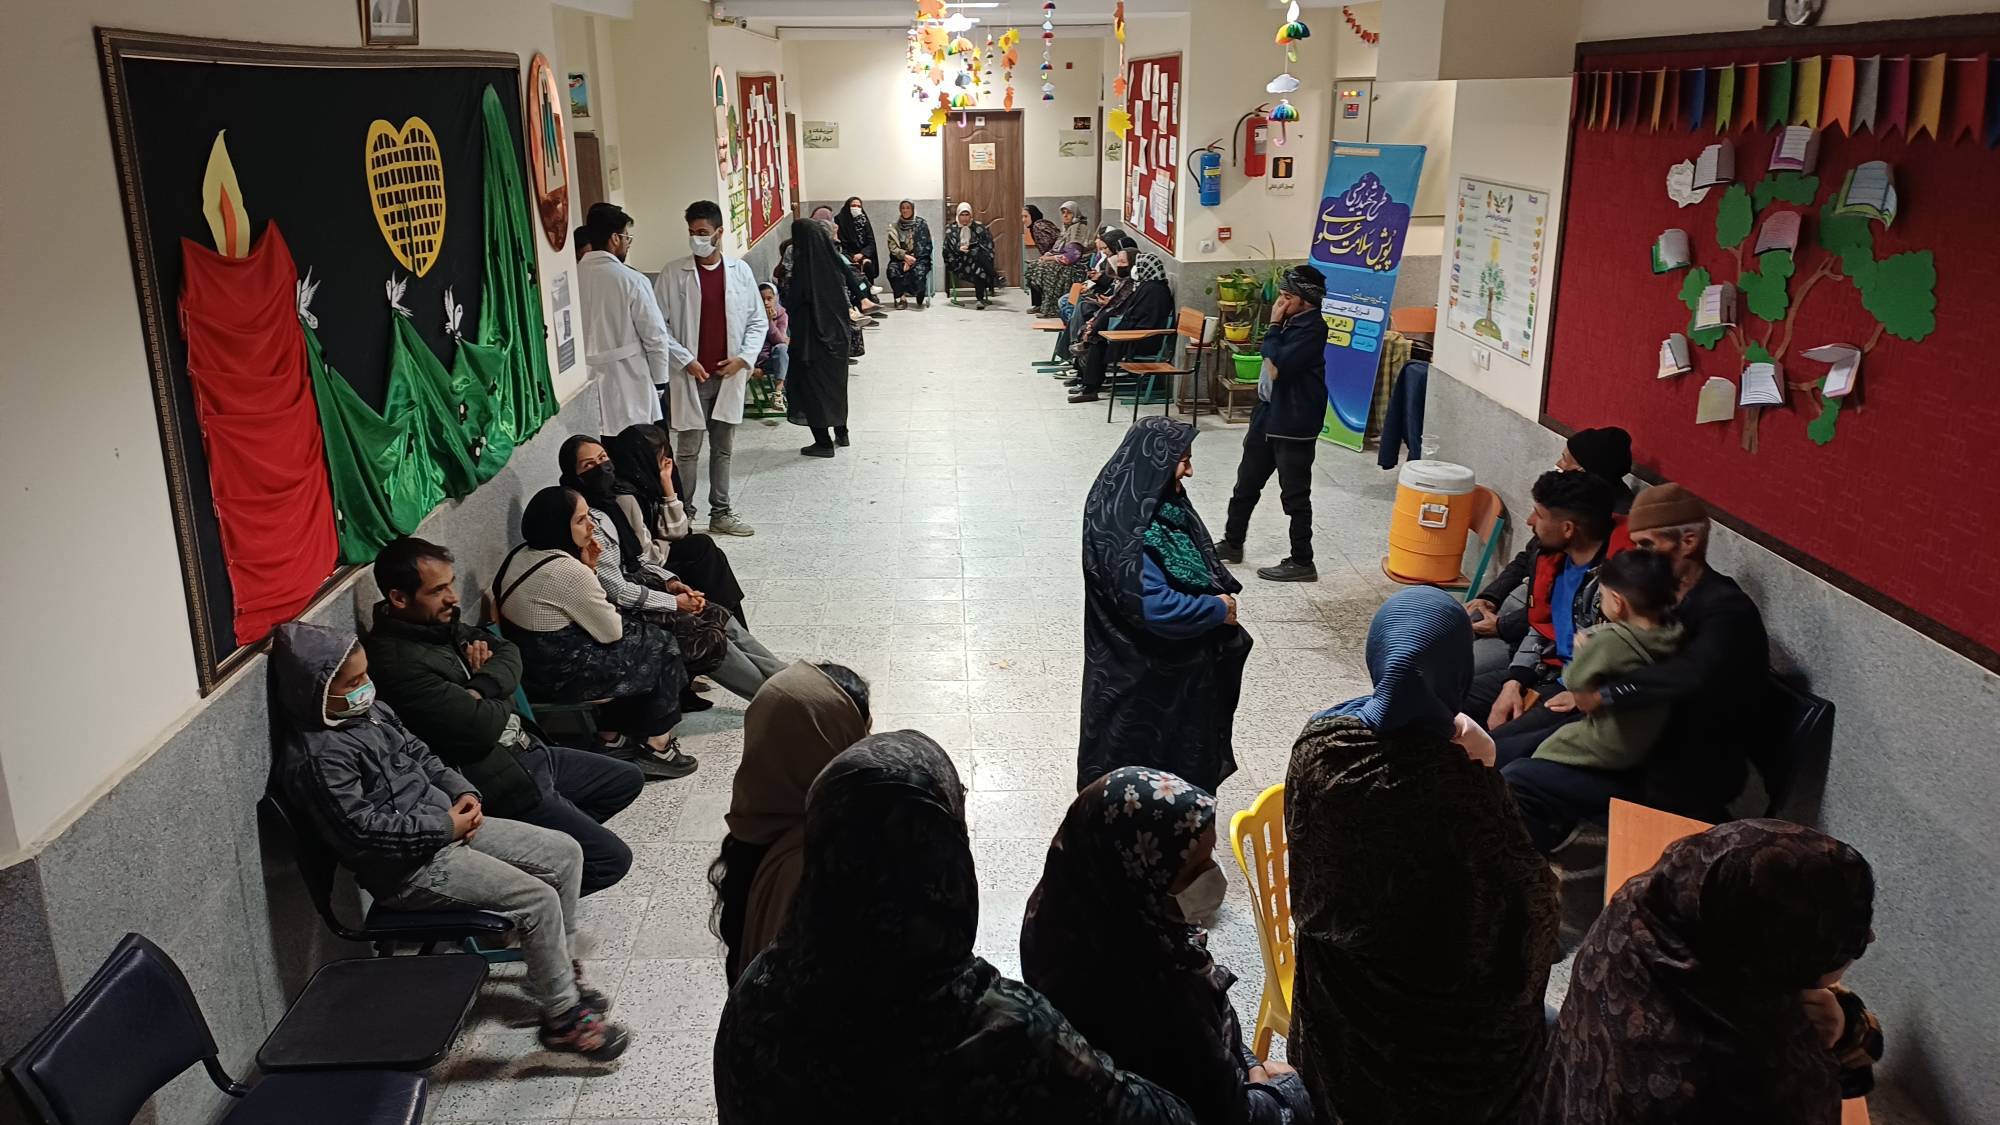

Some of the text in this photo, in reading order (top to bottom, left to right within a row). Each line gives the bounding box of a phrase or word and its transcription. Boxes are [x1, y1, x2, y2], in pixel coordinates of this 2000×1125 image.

[1355, 181, 1378, 215] شهید
[1366, 190, 1388, 221] طرح
[1313, 204, 1397, 270] پویش سلامت علوی
